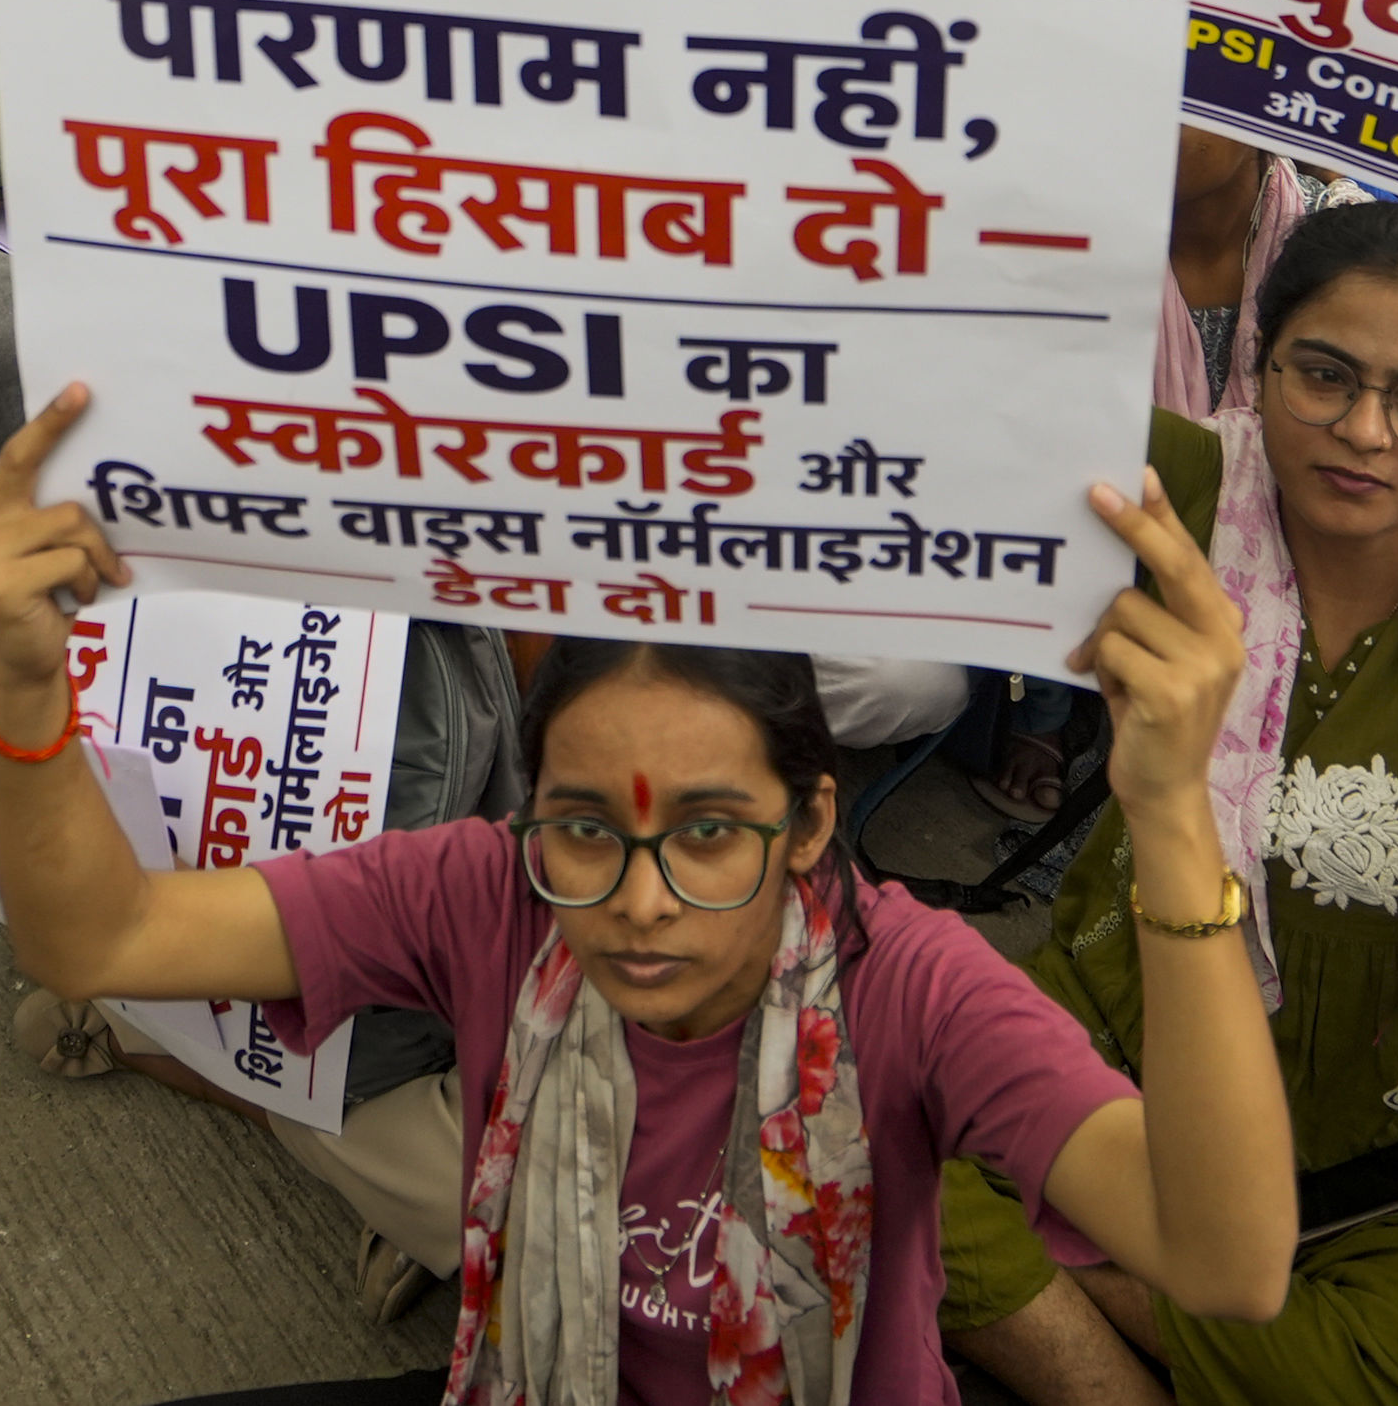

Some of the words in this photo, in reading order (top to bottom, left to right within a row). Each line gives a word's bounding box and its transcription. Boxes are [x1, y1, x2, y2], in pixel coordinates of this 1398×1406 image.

[686, 12, 999, 161] नहीं,
[1188, 20, 1288, 81] PSI,
[1263, 91, 1345, 134] और
[64, 118, 279, 247] पूरा
[315, 111, 746, 268] हिसाब
[787, 158, 942, 283] दो
[222, 277, 625, 398] UPSI
[680, 338, 839, 404] का
[193, 386, 763, 497] स्कोरकार्ड
[798, 438, 925, 500] और
[142, 677, 196, 763] का
[224, 634, 273, 711] और
